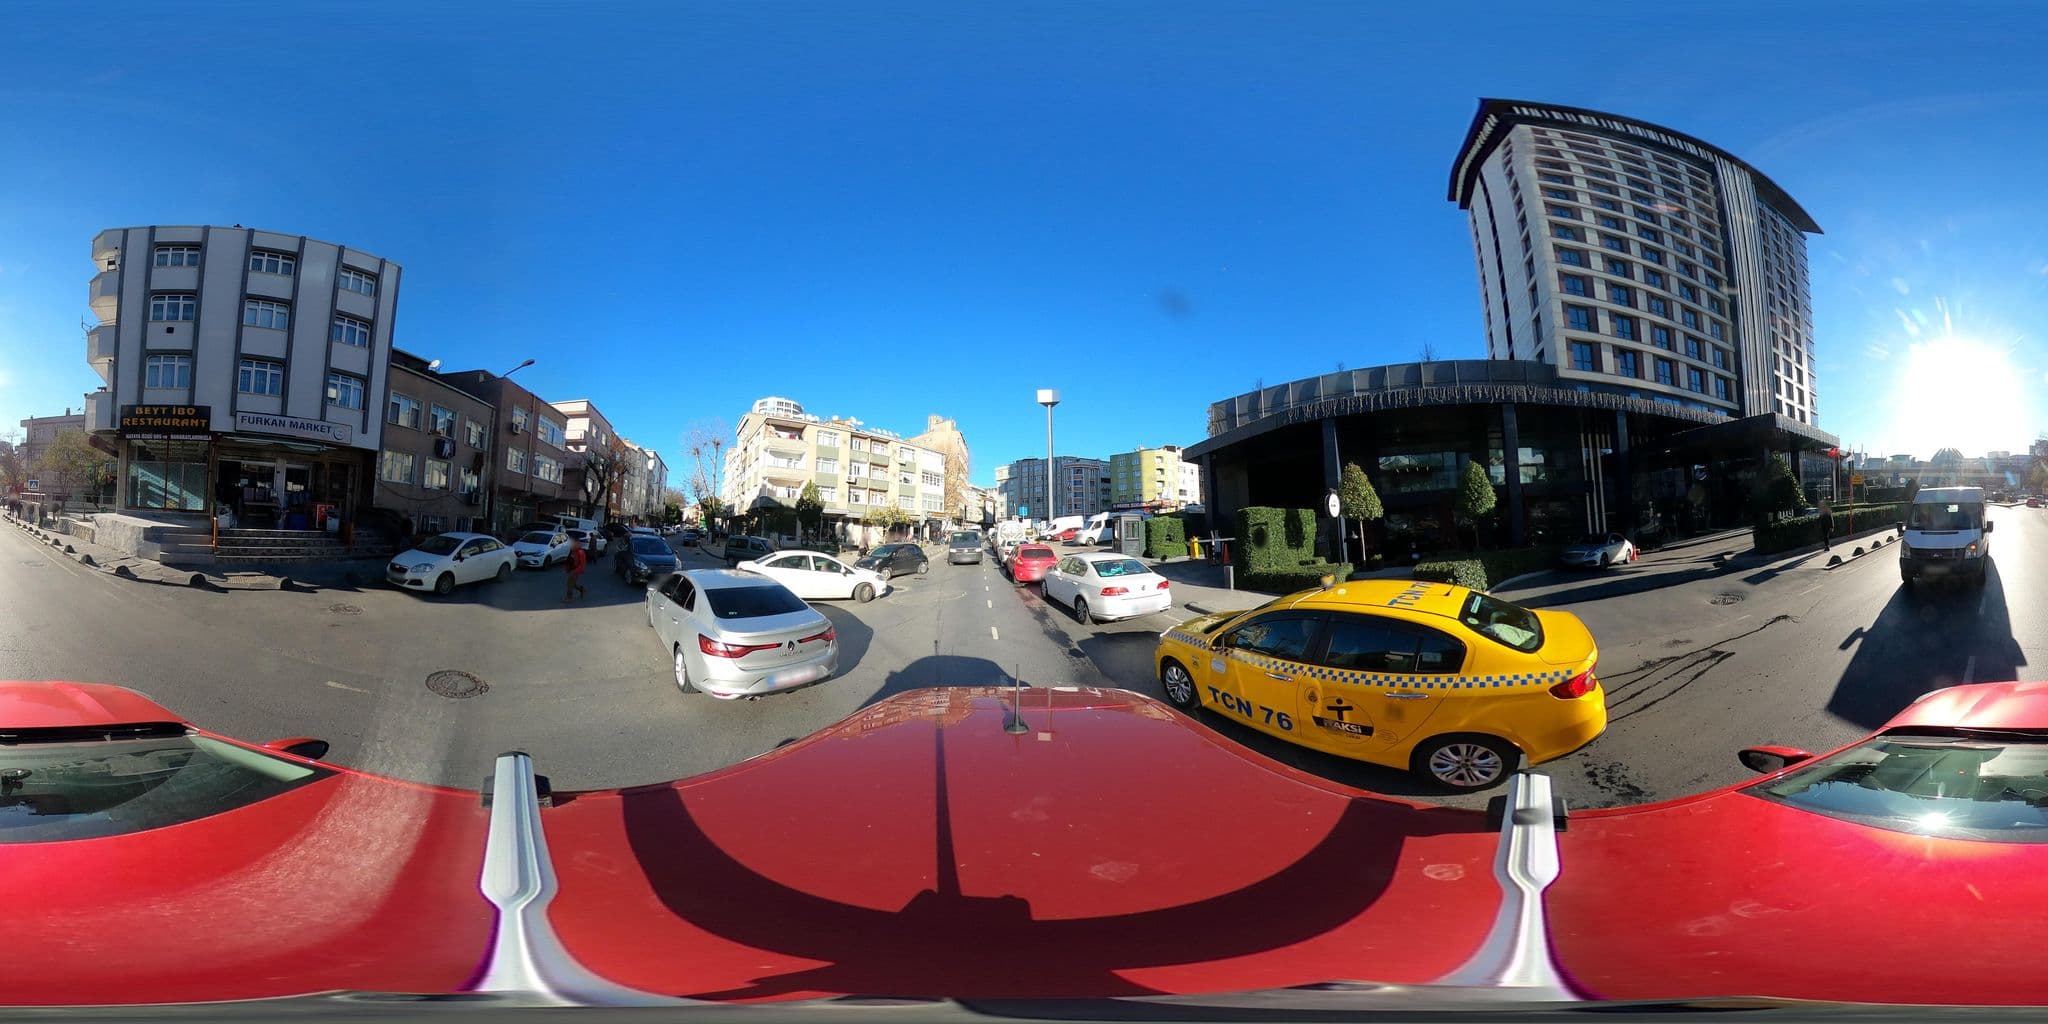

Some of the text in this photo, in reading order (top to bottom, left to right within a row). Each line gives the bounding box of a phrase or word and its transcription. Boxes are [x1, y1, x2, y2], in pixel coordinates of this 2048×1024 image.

[135, 406, 168, 415] BEYT
[122, 417, 207, 427] RESTAURANT
[240, 415, 331, 434] FURKAN MARKET
[1207, 685, 1294, 731] TCN 76
